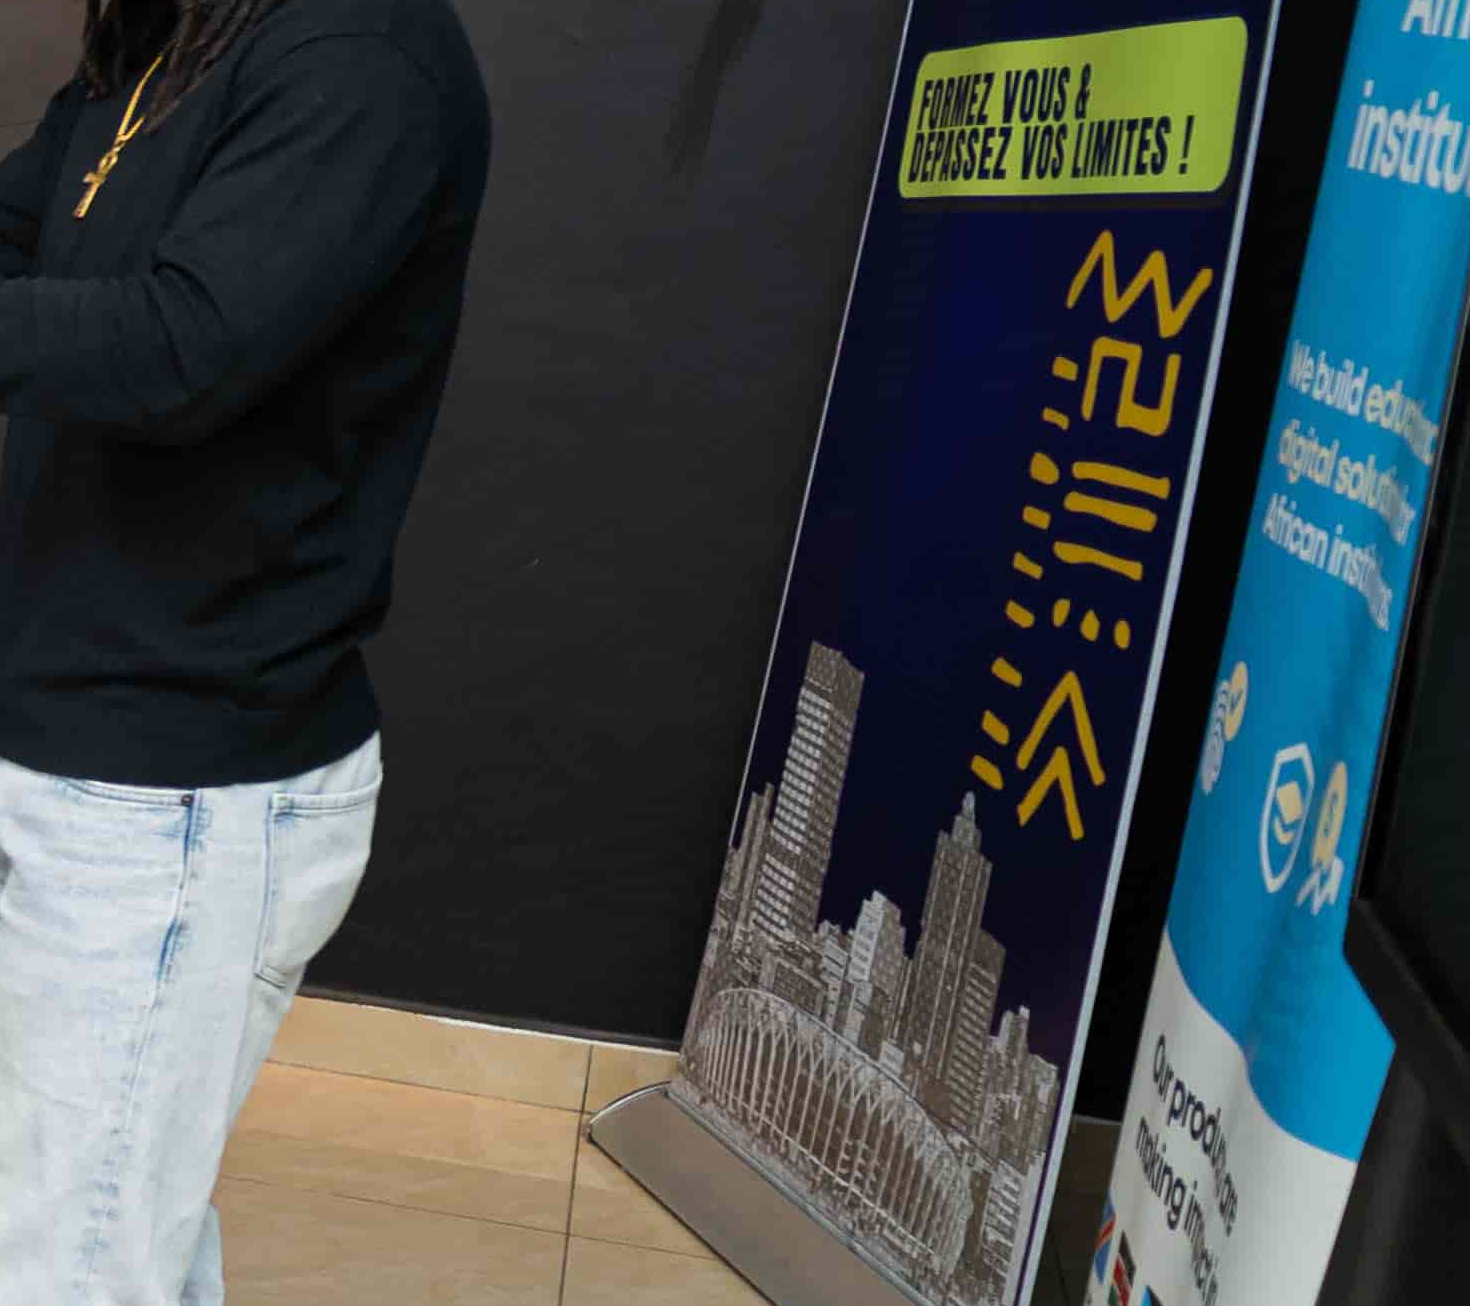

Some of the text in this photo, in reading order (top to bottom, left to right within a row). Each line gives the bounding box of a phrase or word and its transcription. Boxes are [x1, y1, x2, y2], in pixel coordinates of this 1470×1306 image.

[918, 63, 1093, 130] FORMEZ VOUS &
[1020, 125, 1067, 181] VOS
[1070, 115, 1173, 180] LIMITES
[1289, 340, 1369, 417] We build
[1278, 419, 1340, 488] digital
[1262, 492, 1329, 570] African
[1153, 1034, 1174, 1102] Our
